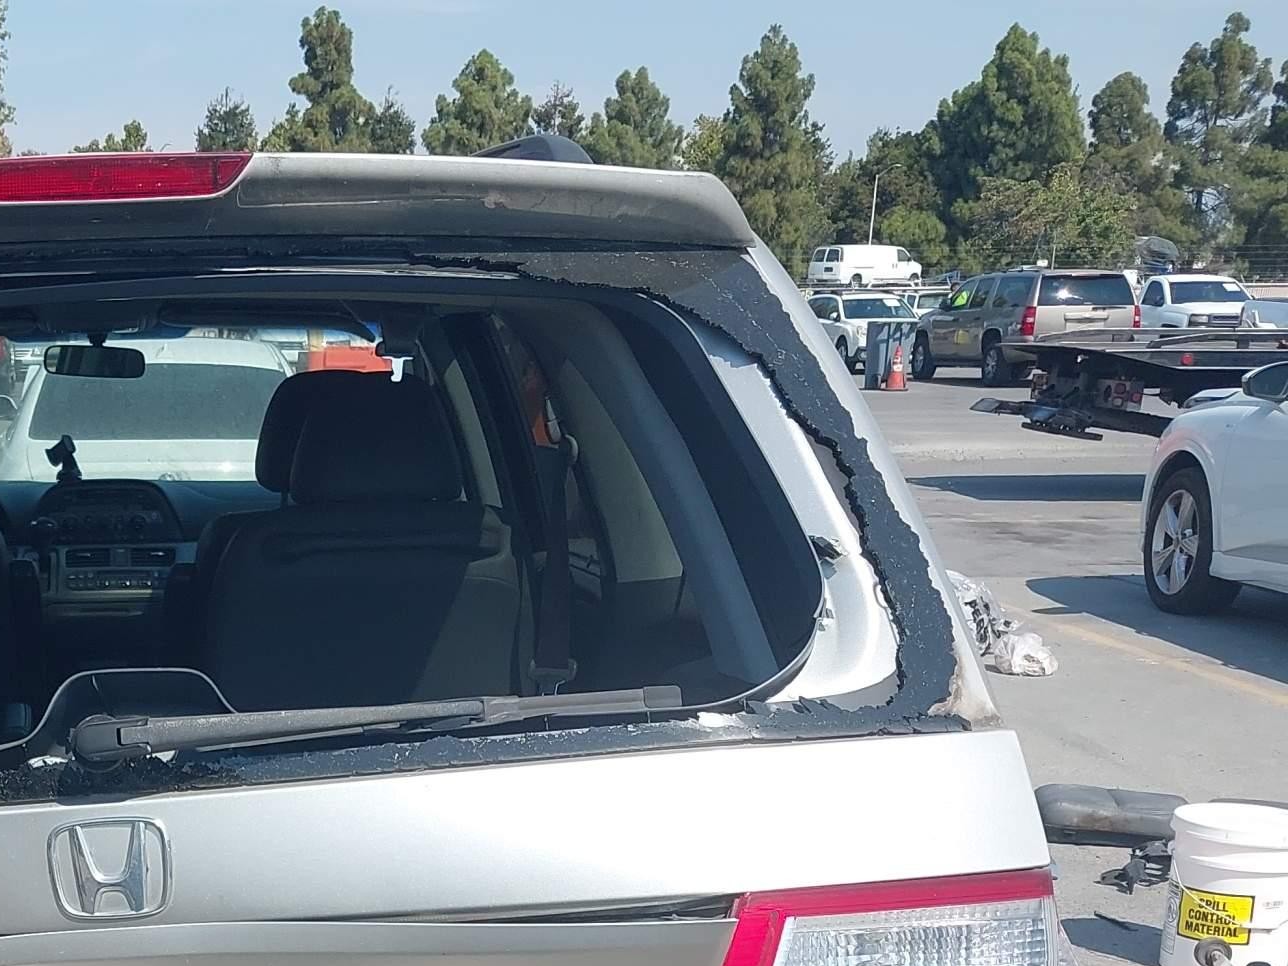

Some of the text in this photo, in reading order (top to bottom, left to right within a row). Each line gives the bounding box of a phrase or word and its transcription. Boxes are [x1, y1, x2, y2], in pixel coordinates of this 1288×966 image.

[1198, 897, 1229, 913] SPILL
[1188, 908, 1239, 926] CONTROL
[1184, 920, 1239, 938] MATERIAL
